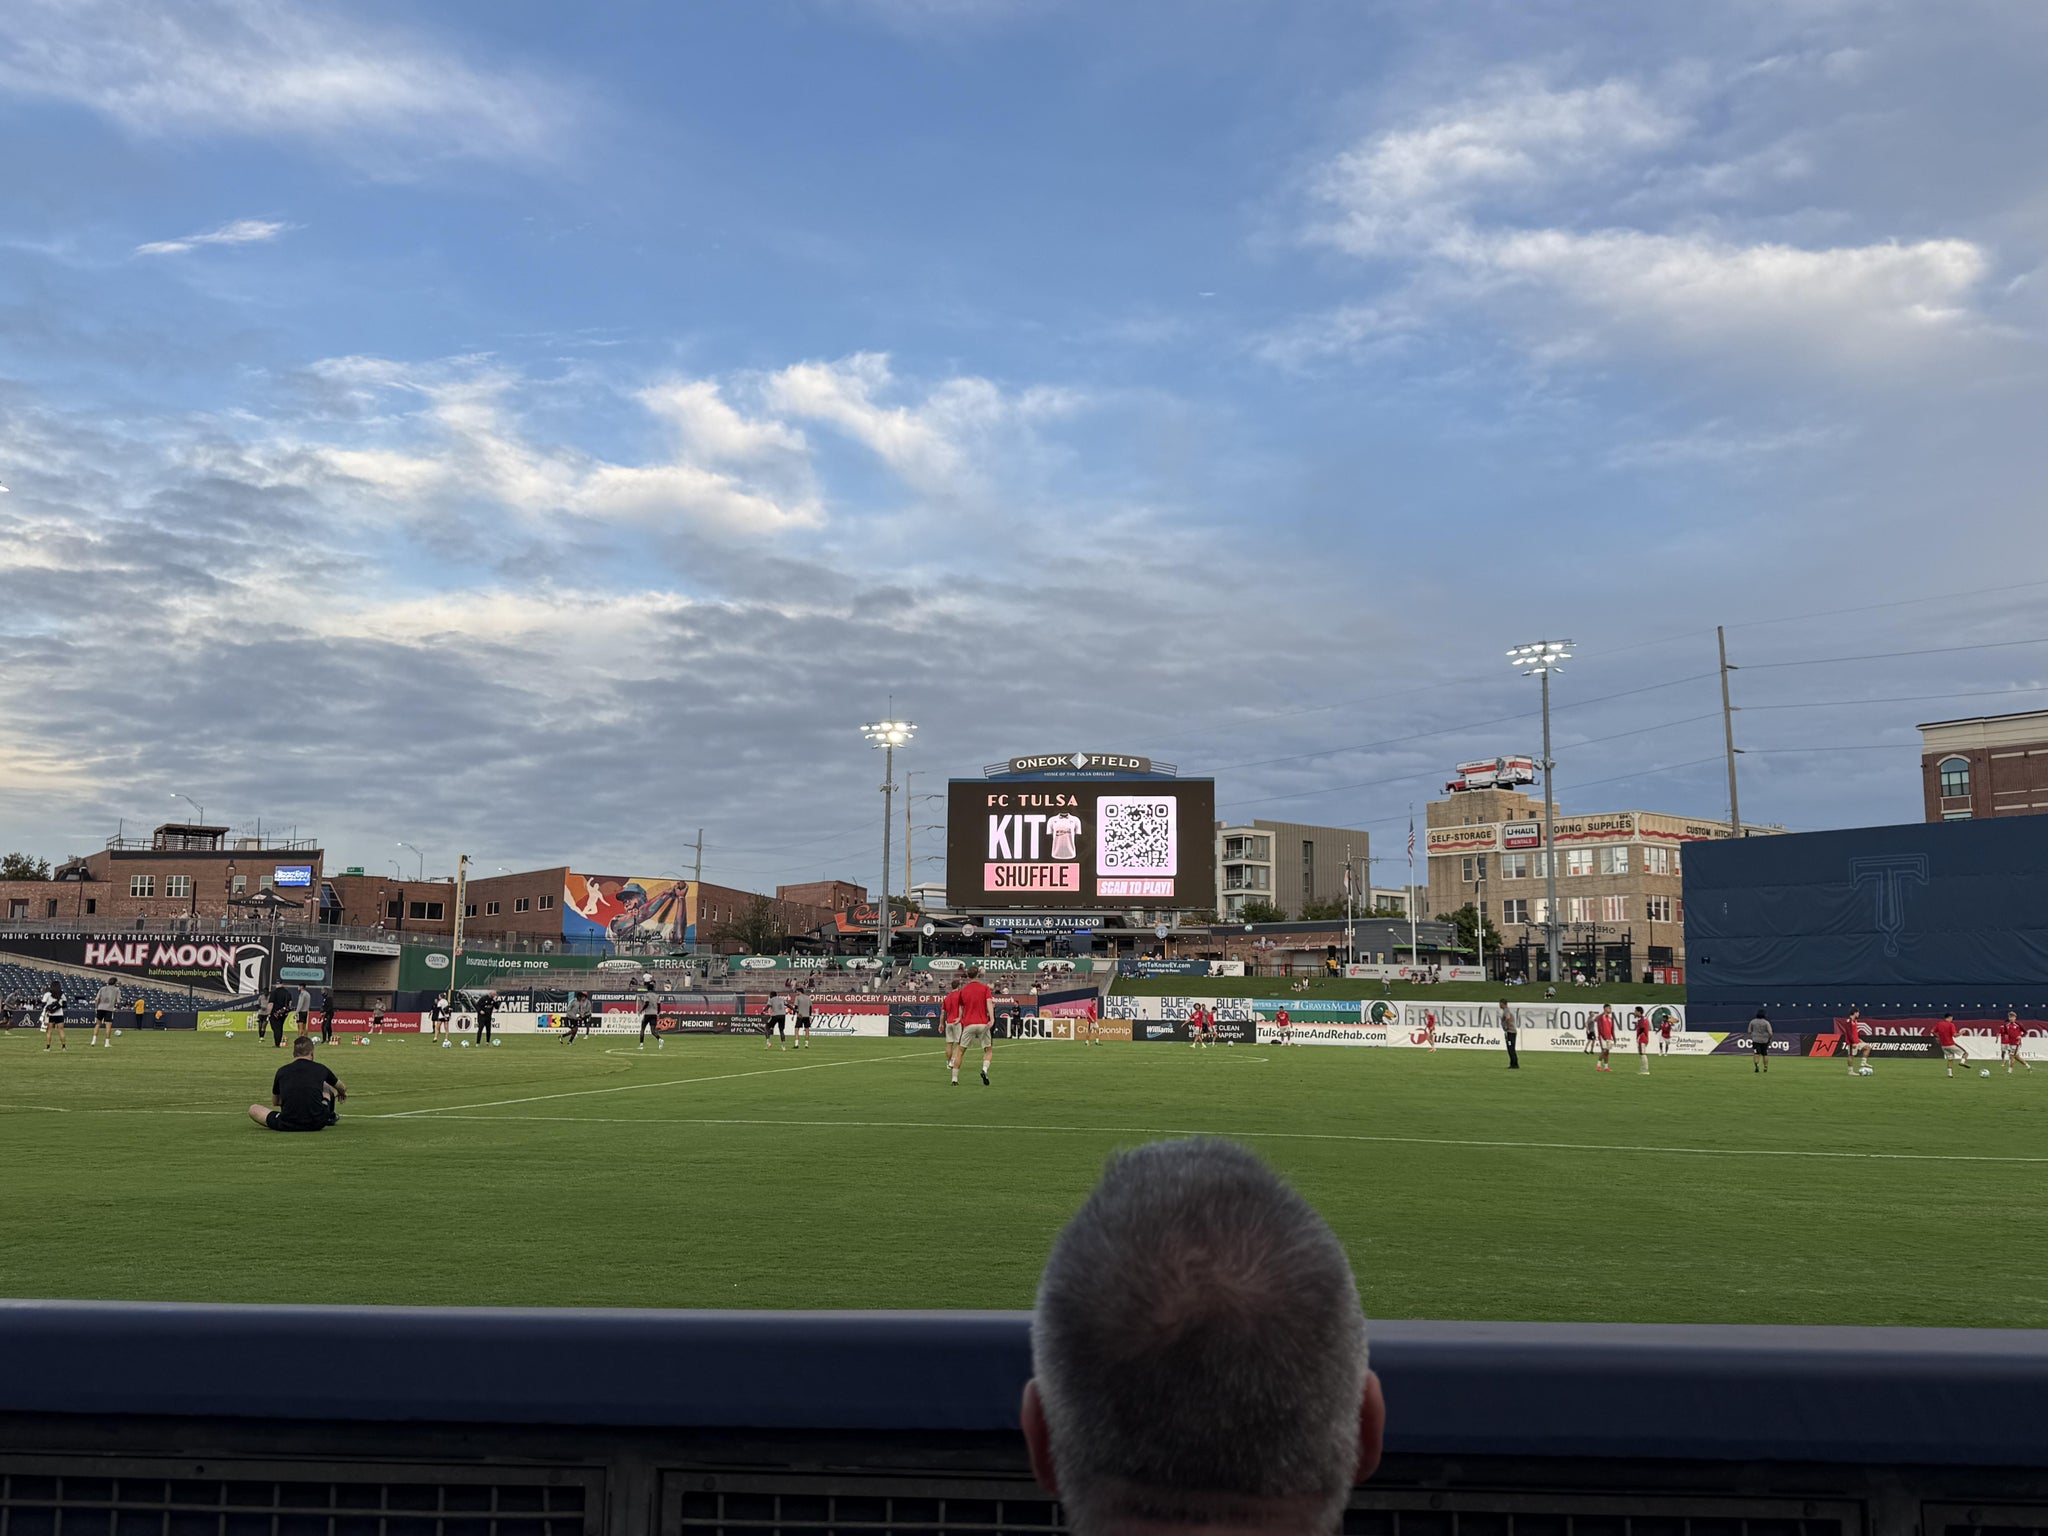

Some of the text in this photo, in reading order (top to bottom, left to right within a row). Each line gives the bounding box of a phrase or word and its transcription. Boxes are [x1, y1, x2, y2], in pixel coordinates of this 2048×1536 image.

[1016, 756, 1140, 769] ONEOK FIELD
[987, 794, 1078, 807] FC TULSA
[1553, 820, 1632, 834] OVING SUPPLIES
[1686, 826, 1734, 838] CUSTOM HITCH
[988, 814, 1047, 860] KIT
[1431, 830, 1492, 843] SELF-STORAGE
[994, 866, 1069, 887] SHUFFLE
[1101, 881, 1128, 894] SCAN
[1129, 881, 1142, 894] TO
[988, 918, 1100, 926] ESTRELLA JALISCO
[280, 942, 320, 954] DESIGN YOUR
[84, 942, 238, 968] HALF MOON
[286, 953, 327, 965] HOME ONLINE
[466, 956, 488, 967] Insurance
[498, 958, 522, 968] does
[524, 960, 549, 969] more
[652, 959, 697, 968] TERRACE
[148, 968, 222, 978] halfmoonplumbing.com
[493, 1002, 530, 1012] AME
[536, 1002, 568, 1012] STRETCH
[1106, 996, 1128, 1006] BLUE
[1160, 998, 1184, 1008] BLUE
[1216, 998, 1240, 1008] BLUE
[1106, 1008, 1137, 1018] HAVEN
[1160, 1008, 1192, 1019] HAVEN
[1216, 1009, 1248, 1020] HAVEN
[1405, 1008, 1637, 1031] GRASSLAS ROONG
[1077, 1026, 1131, 1035] Chpionship
[1257, 1028, 1386, 1040] TulsapineAndRehab.com
[1875, 1027, 1926, 1036] BANK
[1432, 1032, 1500, 1045] ulsaTech.edu
[1737, 1039, 1790, 1051] OC.org
